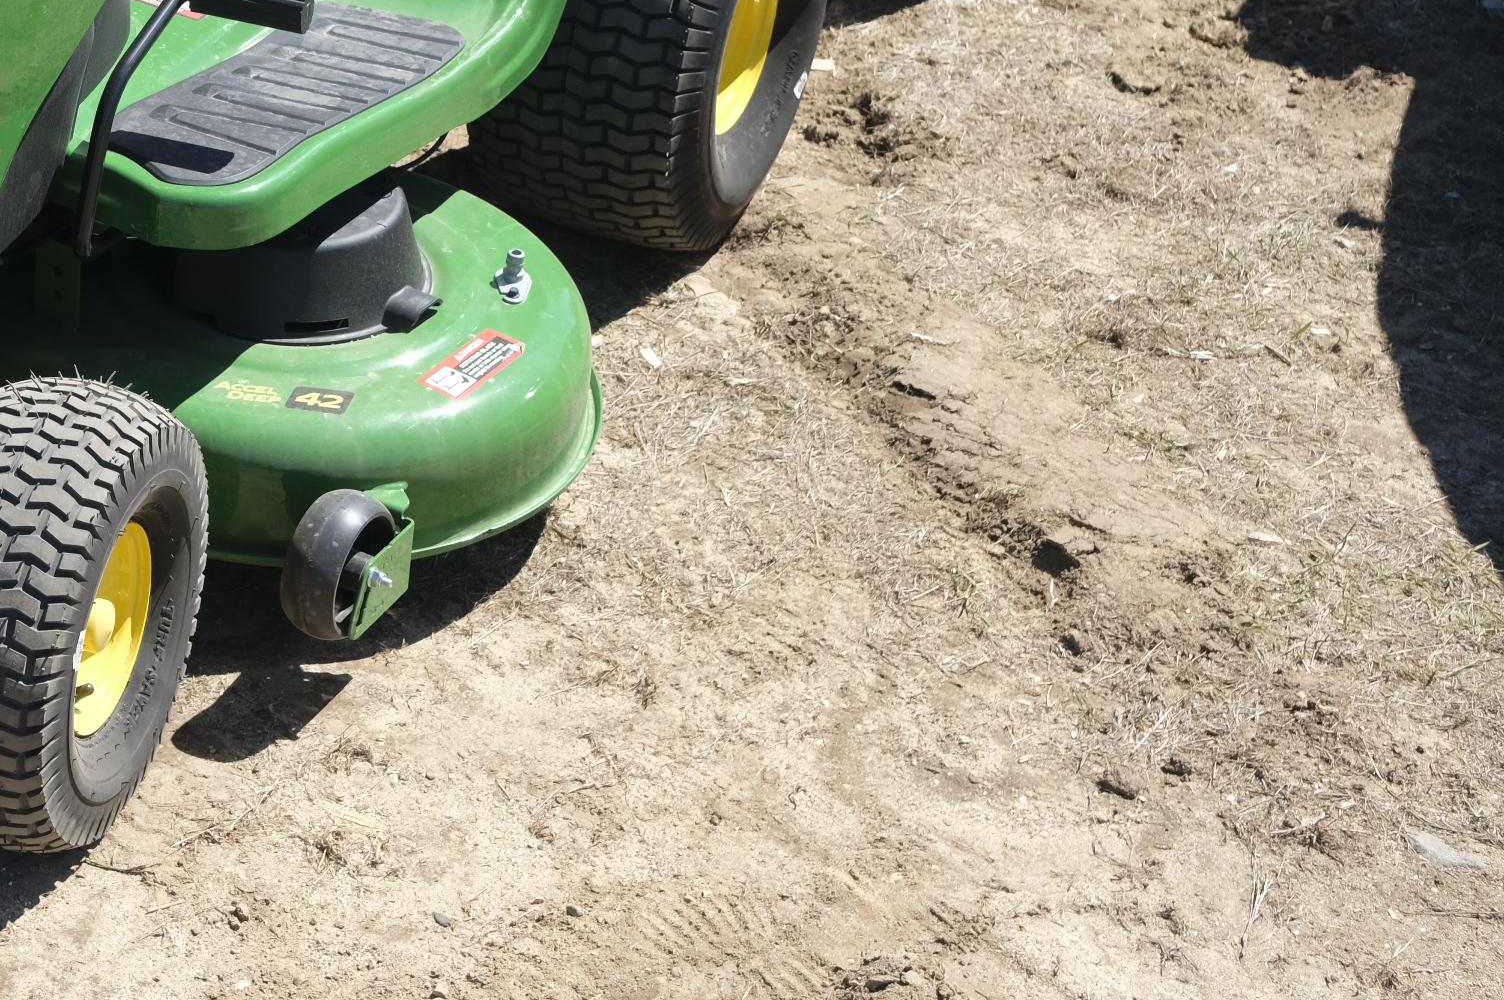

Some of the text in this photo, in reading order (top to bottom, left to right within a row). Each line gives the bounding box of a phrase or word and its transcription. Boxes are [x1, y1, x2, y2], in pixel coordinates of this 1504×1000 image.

[213, 380, 279, 396] ACCEL
[225, 390, 282, 404] DEEP
[294, 392, 345, 410] 42
